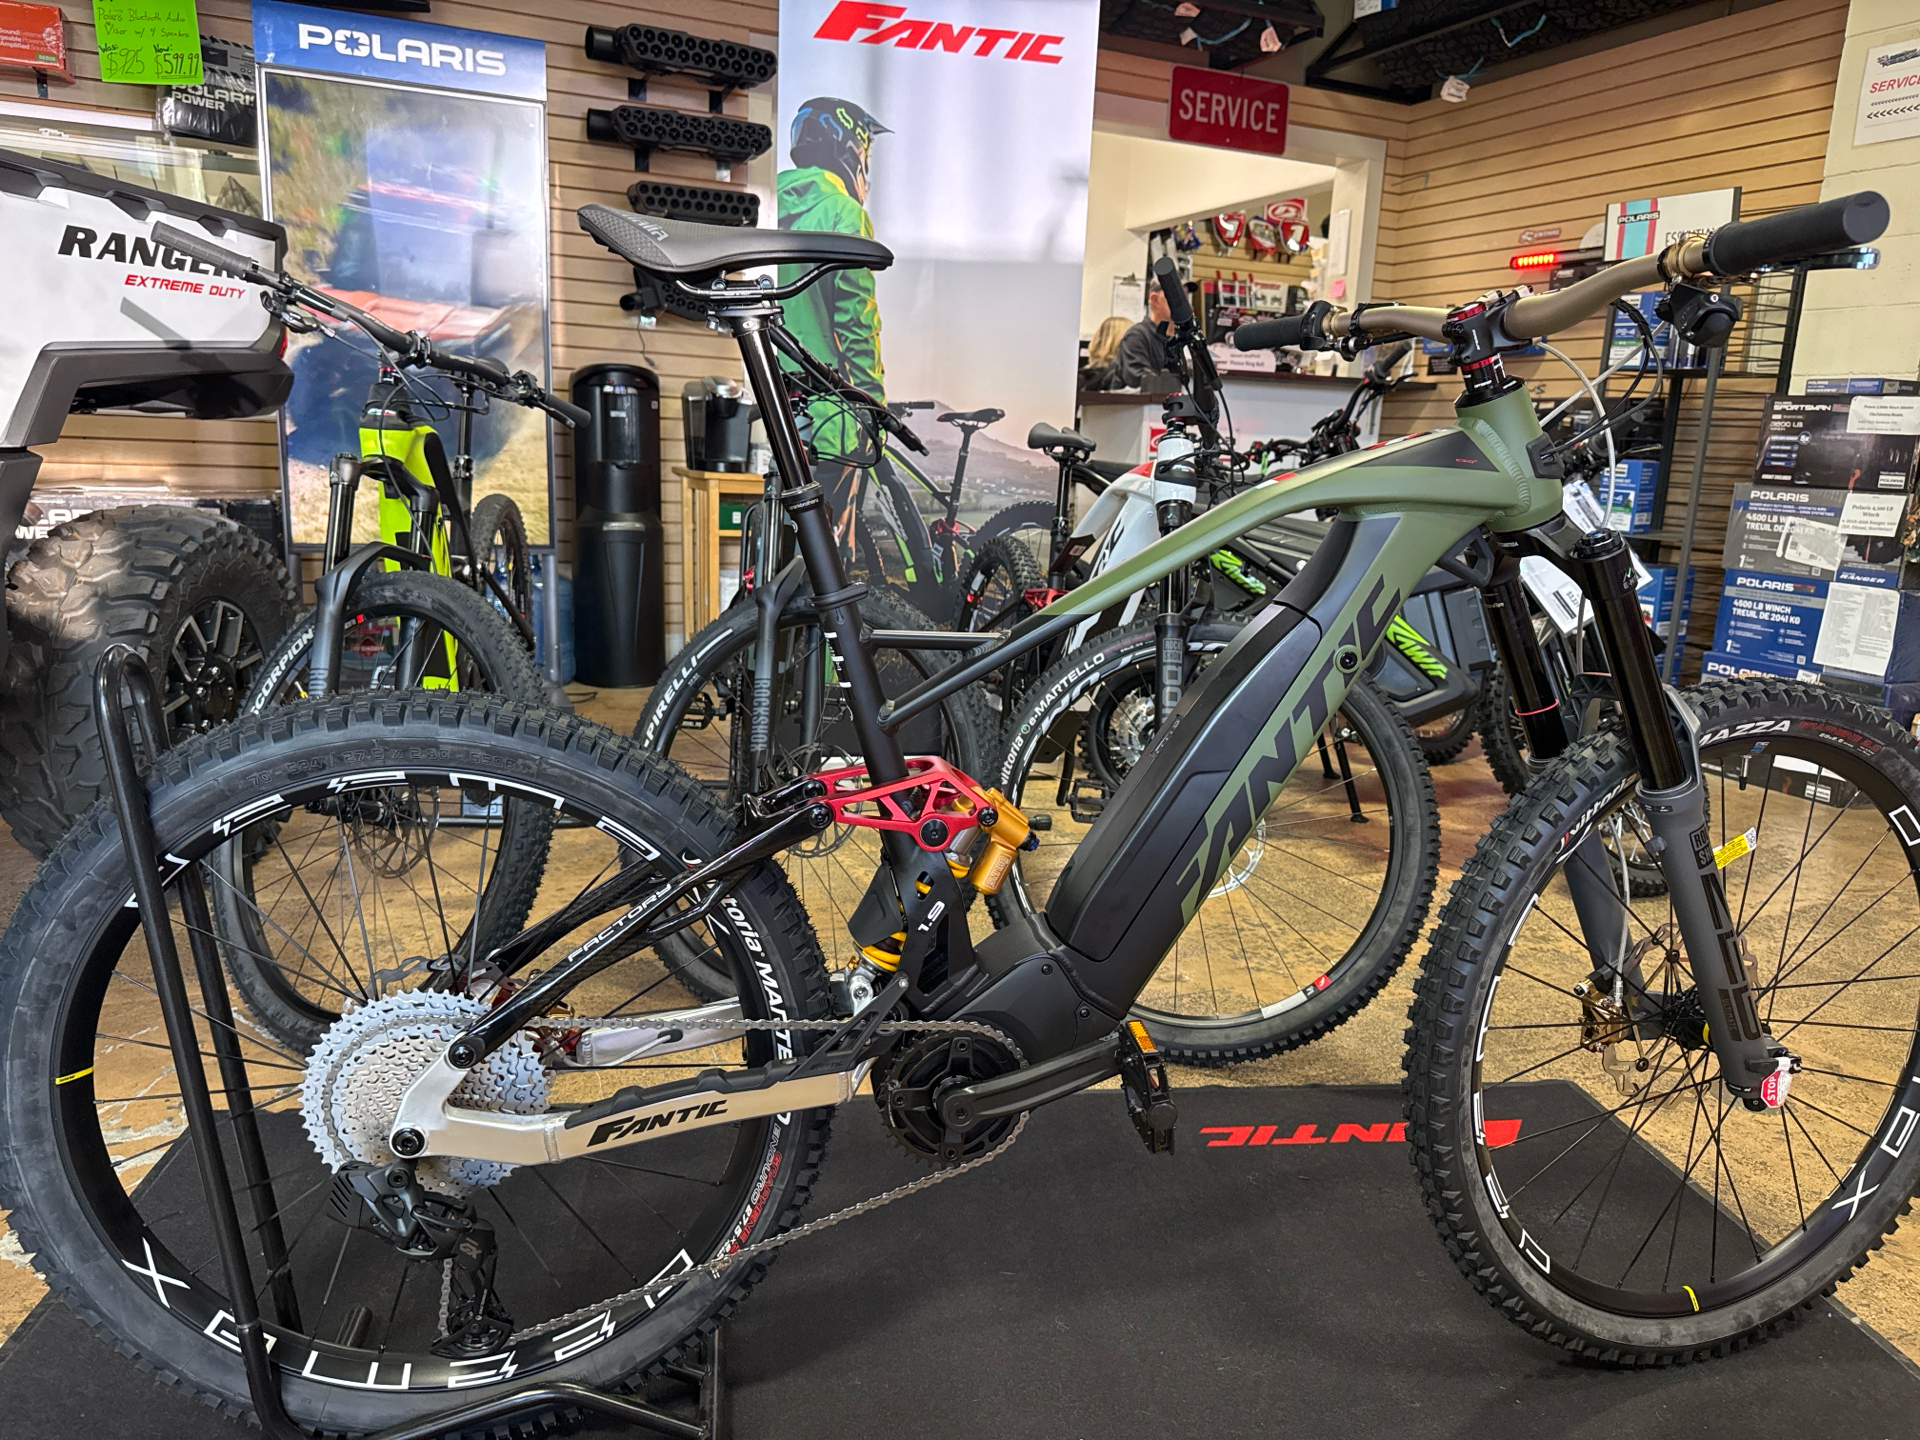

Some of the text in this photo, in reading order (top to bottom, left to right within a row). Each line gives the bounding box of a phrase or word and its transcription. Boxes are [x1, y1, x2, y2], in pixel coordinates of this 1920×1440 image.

[127, 8, 162, 22] Bluetooth
[165, 11, 186, 23] Audio
[813, 0, 1064, 65] FANTIC
[298, 23, 507, 76] POLARIS
[154, 52, 200, 79] $599.99
[171, 90, 226, 111] POWER
[1178, 88, 1281, 134] SERVICE
[1618, 211, 1660, 224] POLARIS
[57, 224, 240, 280] RANG
[124, 274, 247, 299] EXTREME DUTY
[1773, 404, 1832, 412] SPORTSMAN
[1600, 493, 1624, 503] P-4
[1750, 490, 1810, 503] POLARIS
[1746, 513, 1767, 523] 4500
[1767, 514, 1779, 523] LB
[1746, 522, 1772, 532] TREUIL
[1736, 576, 1795, 592] POLARIS
[1839, 573, 1886, 584] RANGER
[1732, 607, 1801, 625] TREUIL DE 2041 KG
[1733, 599, 1792, 614] 4500 LB WINCH
[645, 654, 698, 742] PIRELLI
[1000, 736, 1025, 786] vittoria
[1170, 572, 1401, 948] FANTIC
[567, 883, 672, 963] FACTORY
[717, 890, 765, 957] toria
[917, 900, 946, 932] 1.9
[1766, 1075, 1778, 1102] STOP
[586, 1099, 729, 1148] FANTIC
